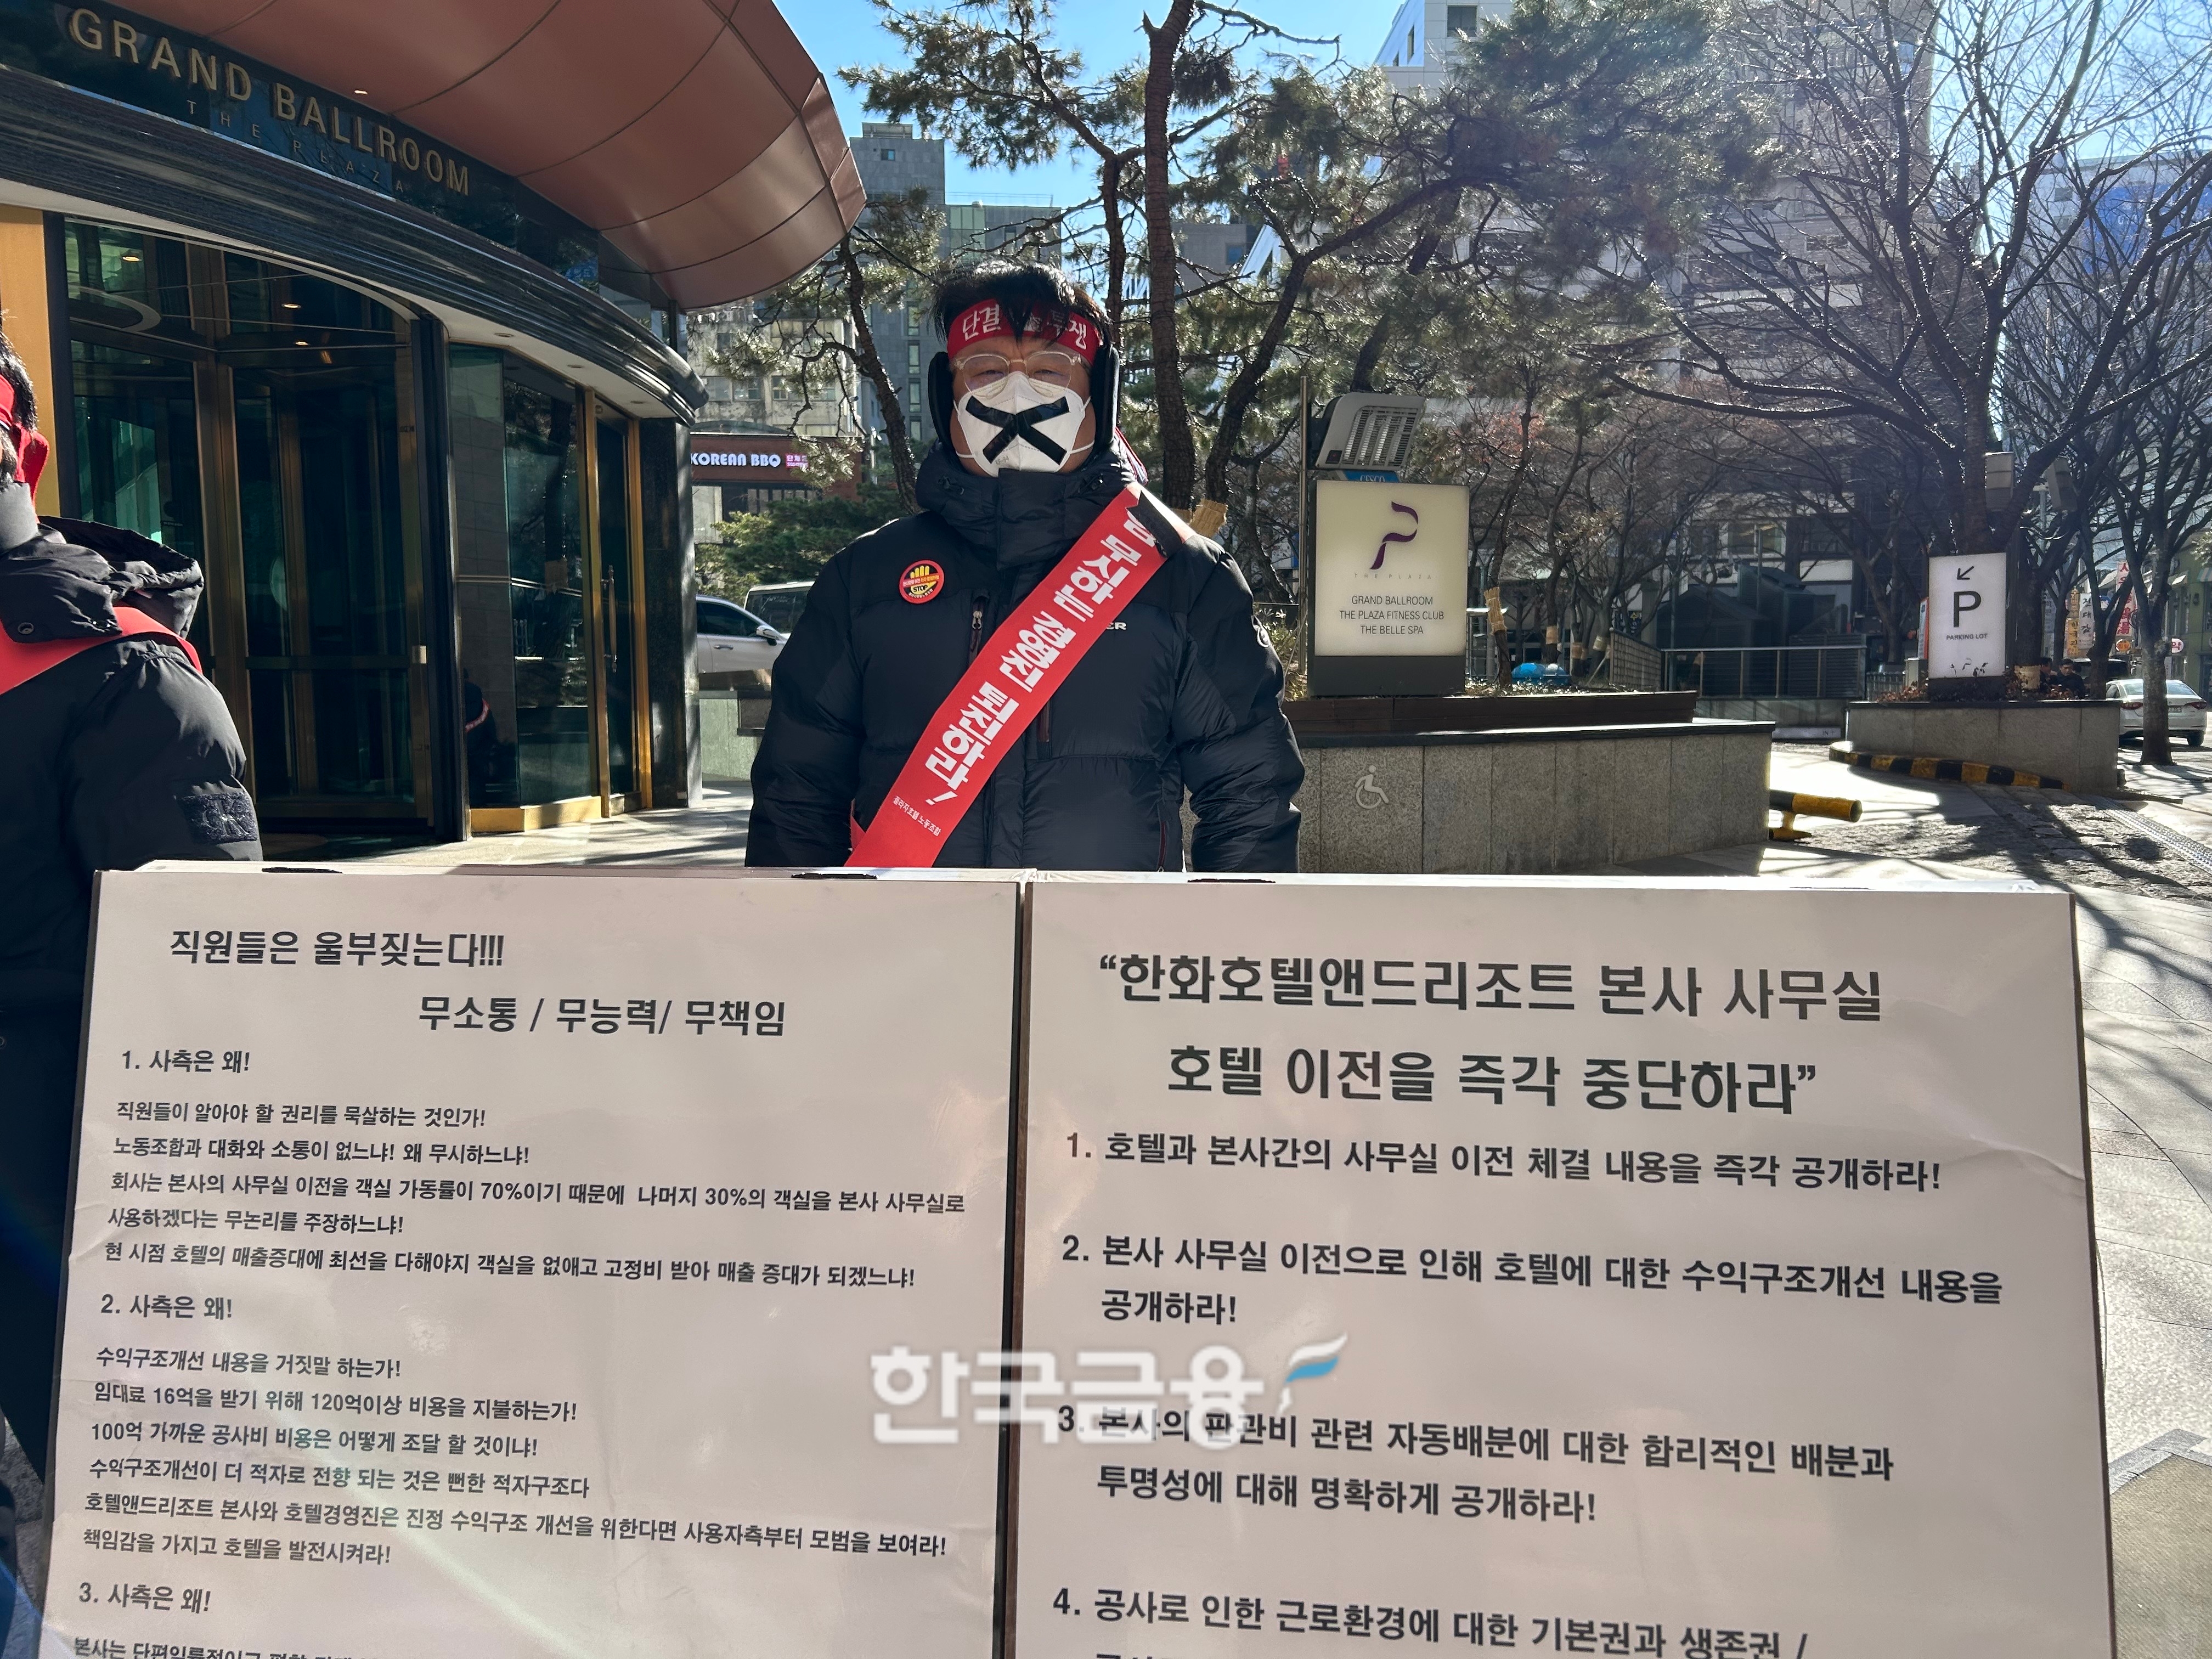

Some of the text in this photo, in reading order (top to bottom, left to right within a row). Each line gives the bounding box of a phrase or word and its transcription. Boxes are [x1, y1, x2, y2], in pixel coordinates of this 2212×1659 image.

[69, 8, 469, 196] GRAND BALLROOM
[187, 99, 261, 138] THE
[962, 303, 1001, 341] 단결
[690, 453, 781, 467] KOREAN BBQ
[1340, 611, 1444, 620] THE PLAZA FITNESS CLUB
[1351, 595, 1433, 605] GRAND BALLROOM
[1954, 591, 1981, 628] P
[1361, 625, 1424, 635] THE BELLE SPA
[1000, 611, 1076, 693] 경영진
[925, 681, 1019, 805] 퇴진하라!
[917, 815, 941, 837] 노동조합
[170, 930, 505, 968] 직원들은 울부짖는다!!!
[1099, 953, 1881, 1022] “한화호텔앤드리조트 본사 사무실
[419, 996, 785, 1036] 무소통 / 무능력/ 무책임
[122, 1049, 250, 1074] 1. 사측은 왜!
[1167, 1045, 1816, 1115] 호텔 이전을 즉각 중단하라”
[116, 1101, 486, 1128] 직원들이 알아야 할 권리를 묵살하는 것인가!
[112, 1137, 529, 1166] 노동조합과 대화와 소통이 없느냐! 왜 무시하느냐!
[1066, 1132, 1940, 1193] 1. 호텔과 본사간의 사무실 이전 체결 내용을 즉각 공개하라!
[111, 1172, 965, 1214] 회사는 본사의 사무실 이전을 객실 가동률이 70%이기 때문에 나머지 30%의 객실을 본사 사무실로
[1062, 1234, 2003, 1305] 2. 본사 사무실 이전으로 인해 호텔에 대한 수익구조개선 내용을
[100, 1294, 232, 1321] 2. 사측은 왜!
[1101, 1289, 1236, 1326] 공개하라!
[96, 1347, 400, 1379] 수익구조개선 내용을 거짓말 하는가!
[94, 1381, 577, 1423] 임대료 16억을 받기 위해 120억이상 비용을 지불하는가!
[1311, 1418, 1373, 1452] 관련
[1386, 1421, 1549, 1462] 자동배분에
[1563, 1431, 1629, 1465] 대한
[1642, 1435, 1776, 1474] 합리적인
[1791, 1443, 1894, 1482] 배분과
[1097, 1465, 1595, 1524] 투명성에 대해 명확하게 공개하라!
[84, 1492, 946, 1558] 호텔앤드리조트 본사와 호텔경영진은 진정 수익구조 개선을 위한다면 사용자측부터 모범을 보여라!
[83, 1528, 391, 1566] 책임감을 가지고 호텔을 발전시켜라!
[78, 1582, 211, 1614] 3. 사측은 왜!
[1053, 1587, 1081, 1616] 4.
[1094, 1588, 1189, 1624] 공사로
[1202, 1595, 1265, 1630] 인한
[1276, 1600, 1439, 1644] 근로환경에
[1453, 1612, 1519, 1648] 대한
[1531, 1617, 1667, 1659] 기본권과
[75, 1637, 126, 1658] 본사는
